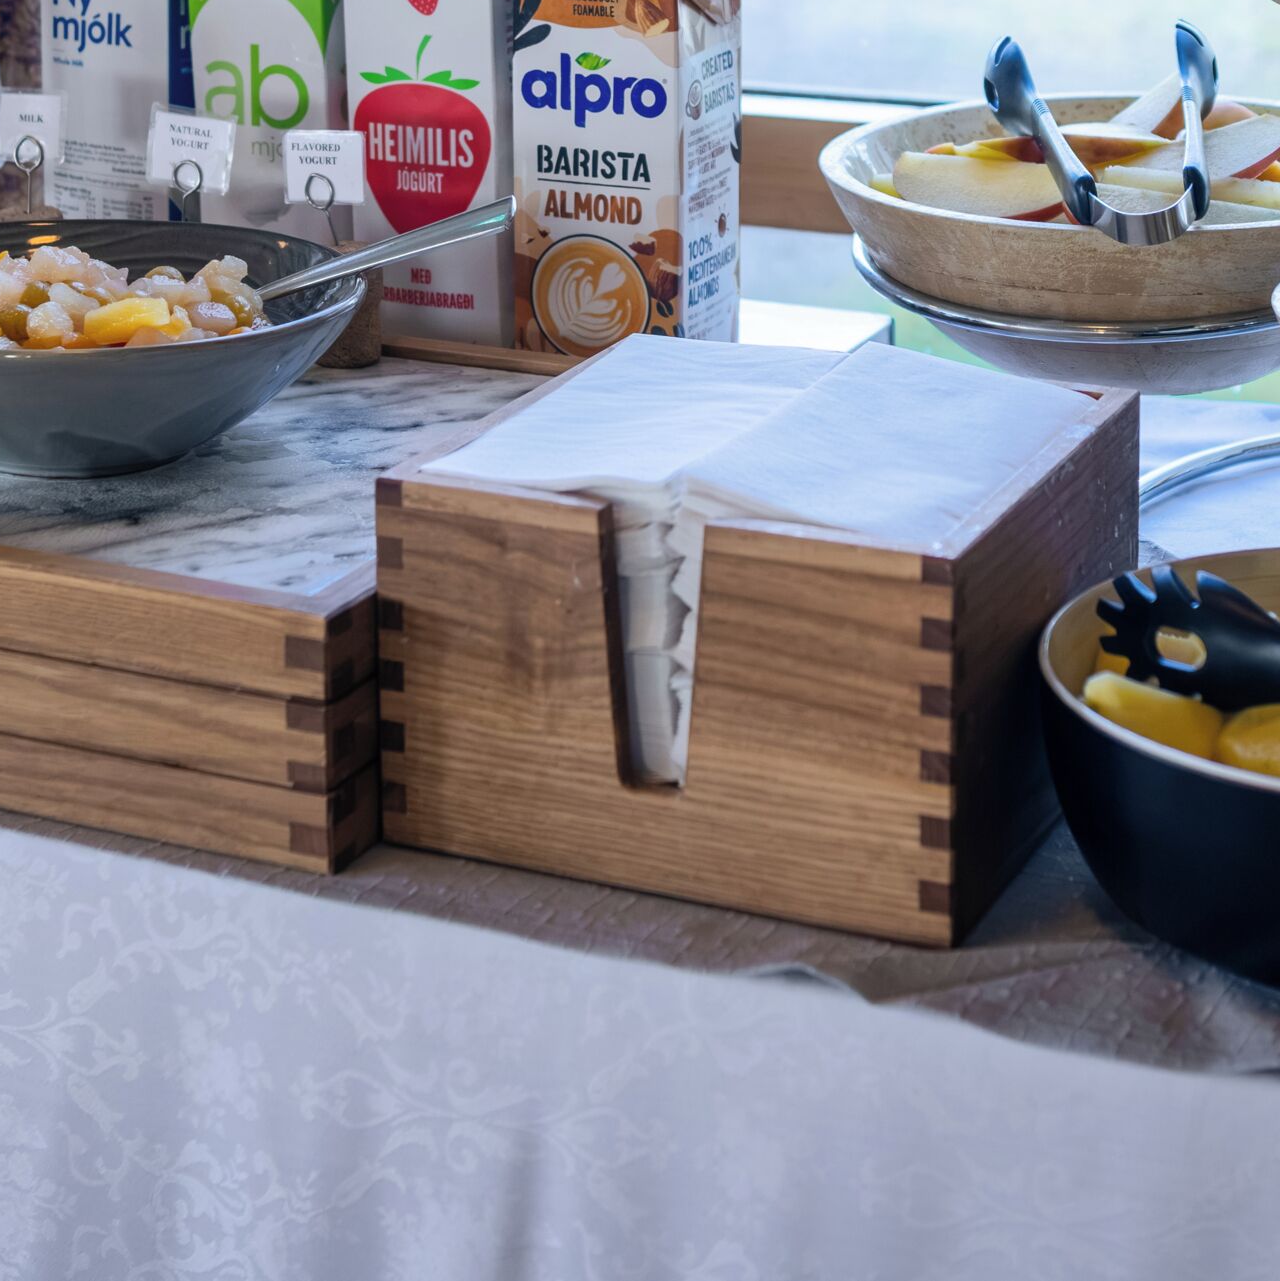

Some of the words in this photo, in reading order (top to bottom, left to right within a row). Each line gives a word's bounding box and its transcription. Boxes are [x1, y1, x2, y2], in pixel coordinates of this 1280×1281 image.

[572, 5, 615, 18] FOAMABLE
[52, 12, 133, 53] mjólk
[701, 49, 734, 81] CREATED
[205, 43, 310, 130] ab
[521, 52, 668, 129] alpro
[704, 81, 735, 114] BARISTAS
[19, 114, 44, 123] MILK
[170, 123, 214, 139] NATURAL
[171, 136, 210, 150] YOGURT
[291, 142, 342, 152] FLAVORED
[369, 122, 475, 169] HEIMILIS
[298, 155, 338, 165] YOGURT
[536, 144, 652, 183] BARISTA
[396, 165, 445, 195] JÓGÚRT
[544, 189, 643, 226] ALMOND
[687, 231, 713, 262] 100%
[687, 274, 720, 310] ALMONDS
